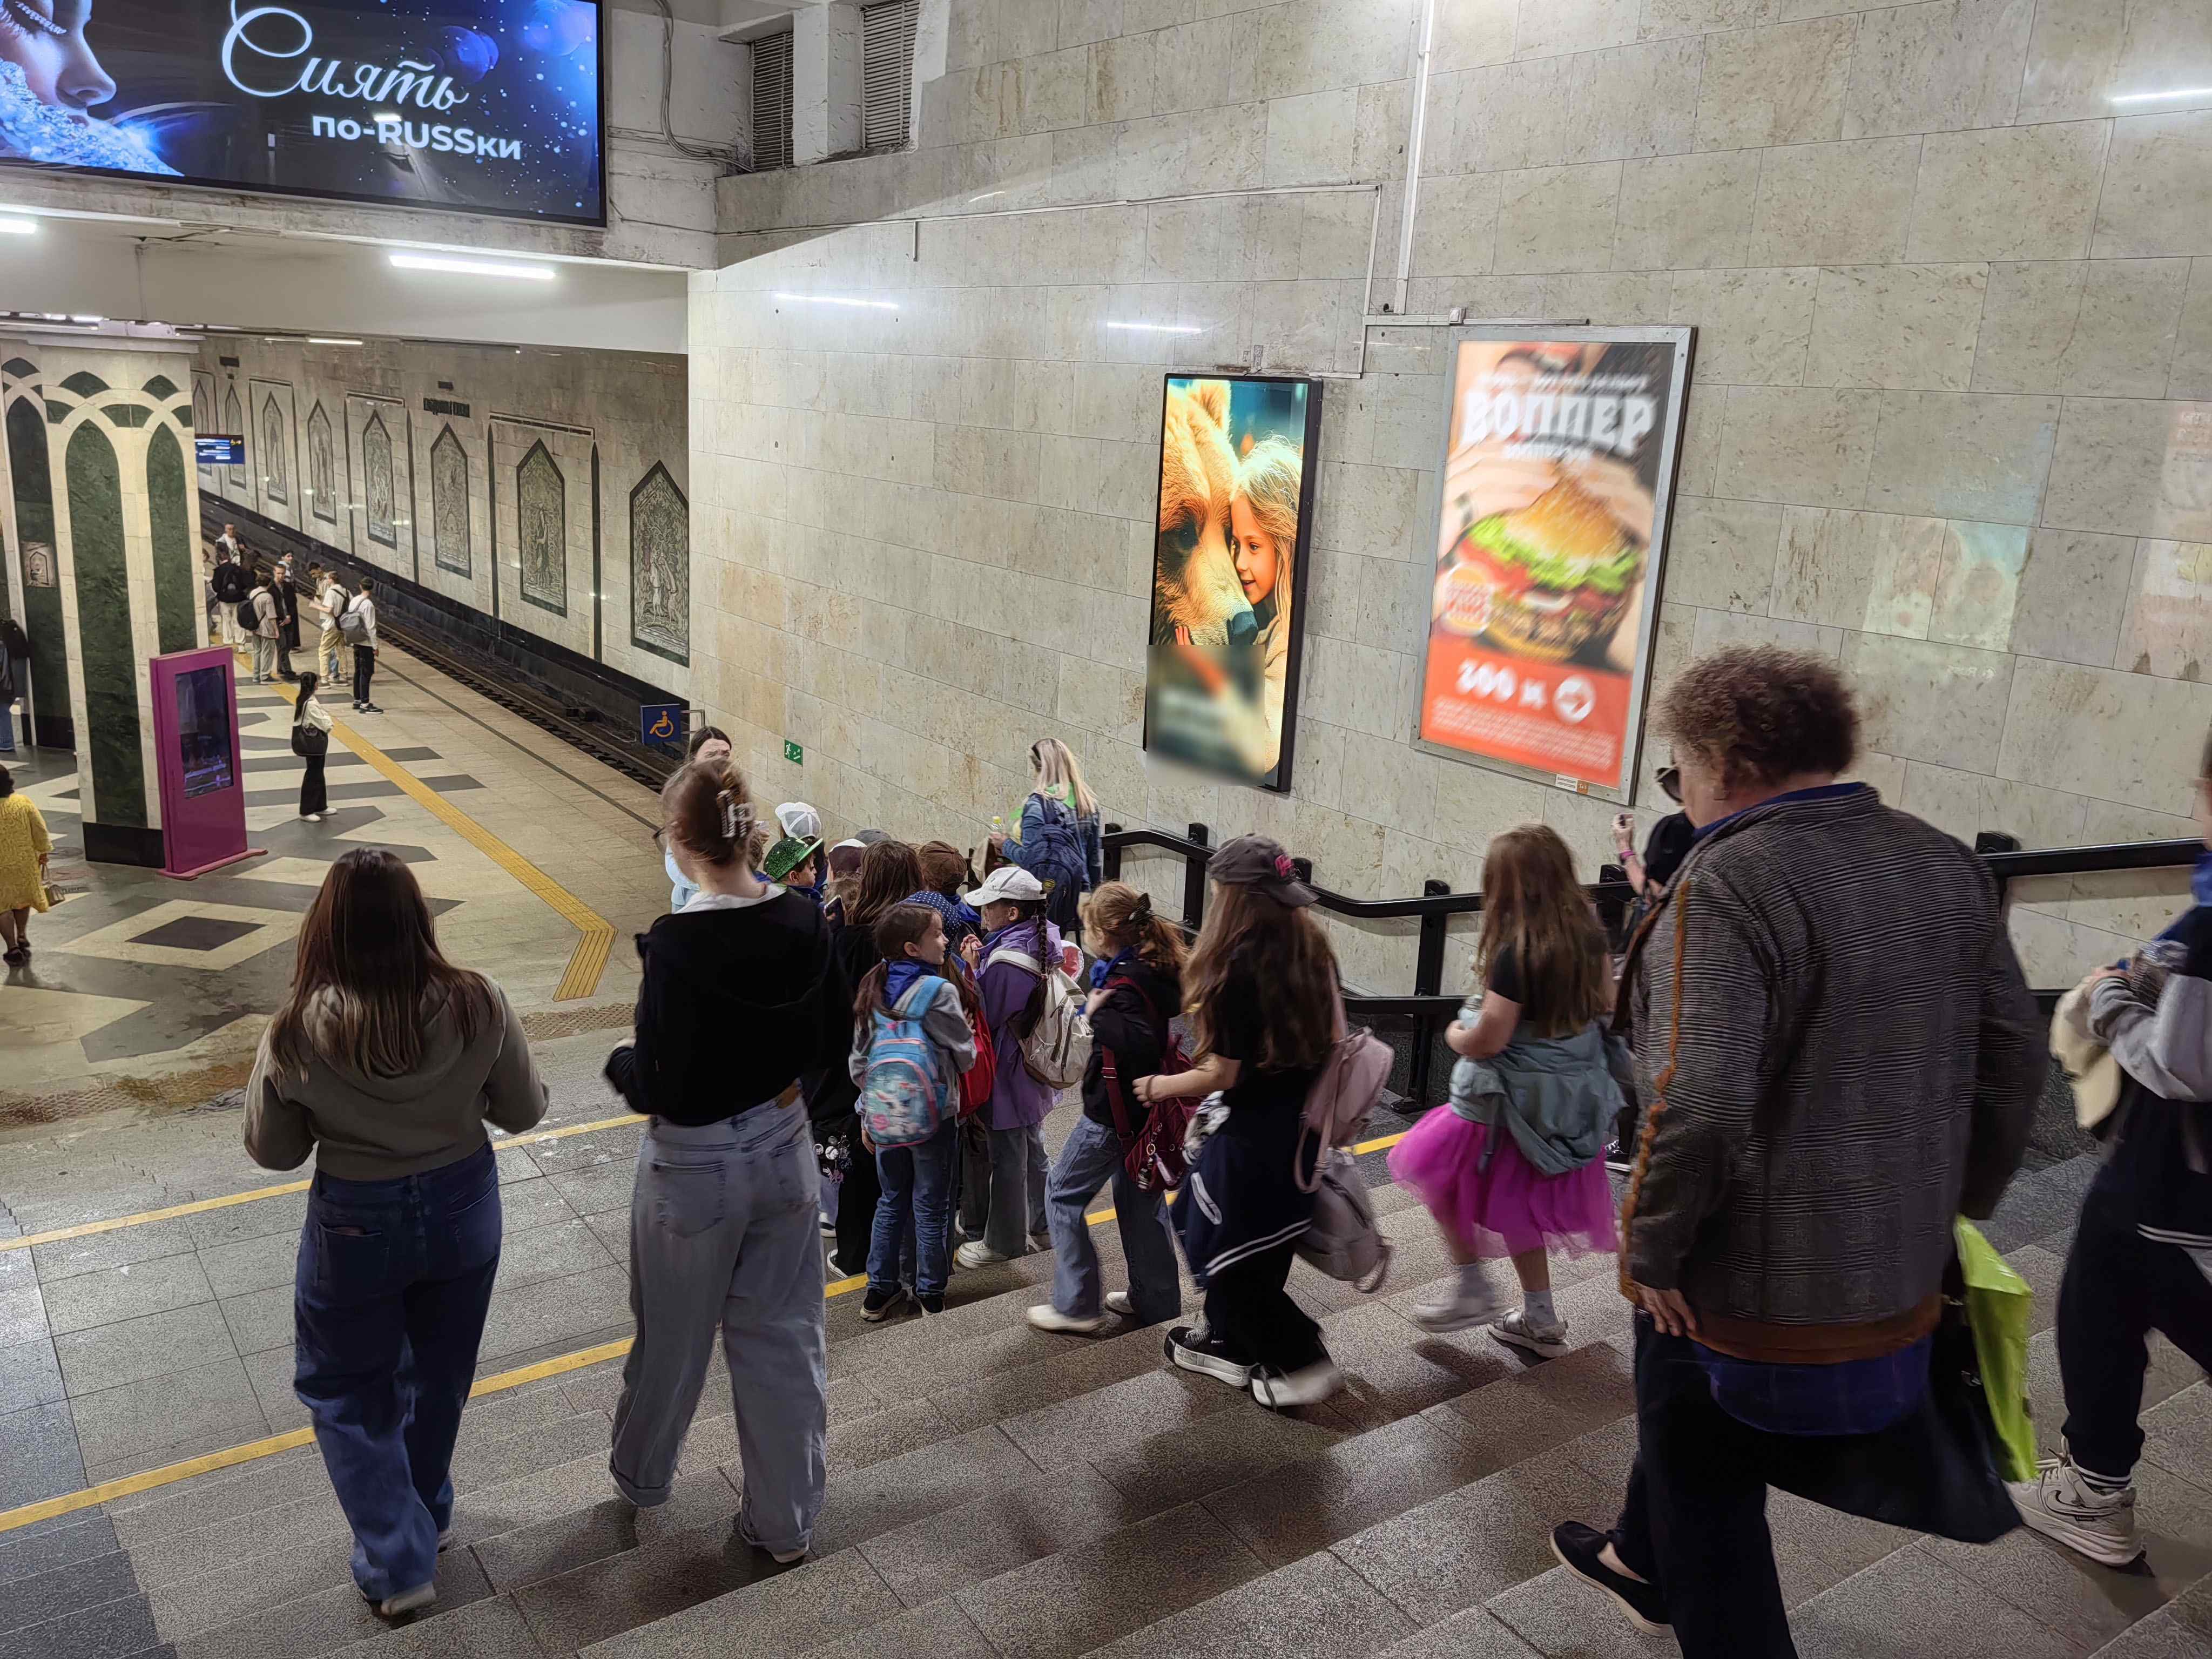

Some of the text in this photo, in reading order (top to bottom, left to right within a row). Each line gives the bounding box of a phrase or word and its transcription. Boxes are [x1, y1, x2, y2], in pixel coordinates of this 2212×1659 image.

[222, 0, 469, 110] Сиять
[312, 115, 521, 160] по-RUSSки
[1462, 390, 1658, 456] ВОППЕР
